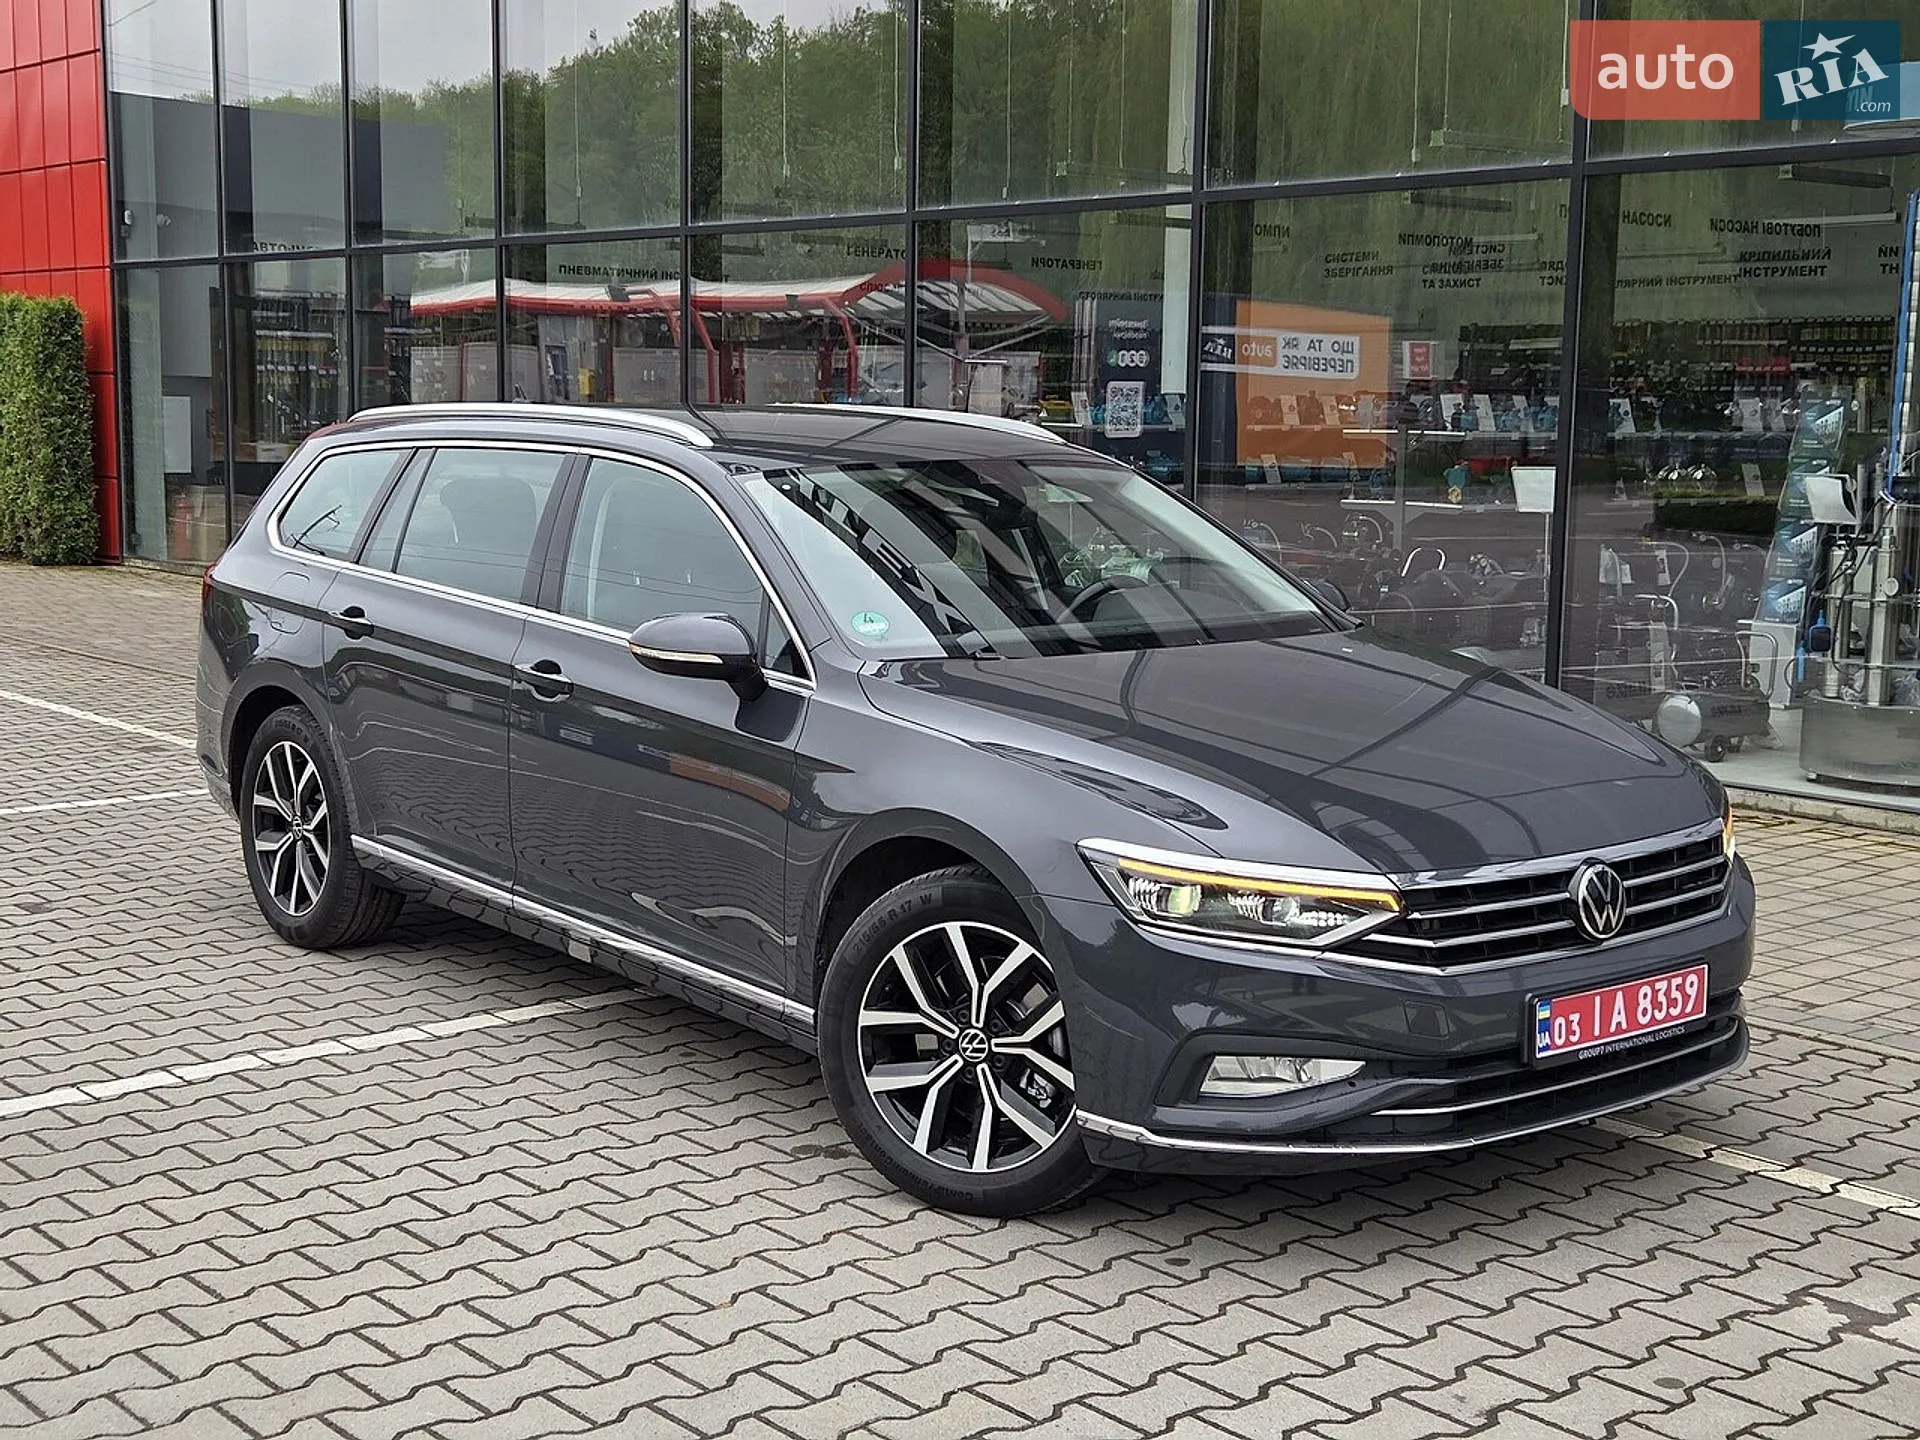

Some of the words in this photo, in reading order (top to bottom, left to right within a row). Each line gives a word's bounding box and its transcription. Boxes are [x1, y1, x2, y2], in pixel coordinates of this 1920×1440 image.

[1622, 209, 1672, 228] НАСОСИ
[1325, 251, 1379, 263] СИСТЕМИ
[559, 264, 658, 280] ПНЕВМАТИЧНИЙ
[1324, 265, 1393, 279] ЗБЕРІГАННЯ
[1422, 279, 1436, 289] ТА
[1439, 277, 1482, 289] ЗАХИСТ
[920, 892, 933, 905] W
[1553, 1012, 1581, 1046] 03
[1637, 973, 1699, 1025] 8359
[1605, 1033, 1655, 1053] INTERNATIONAL
